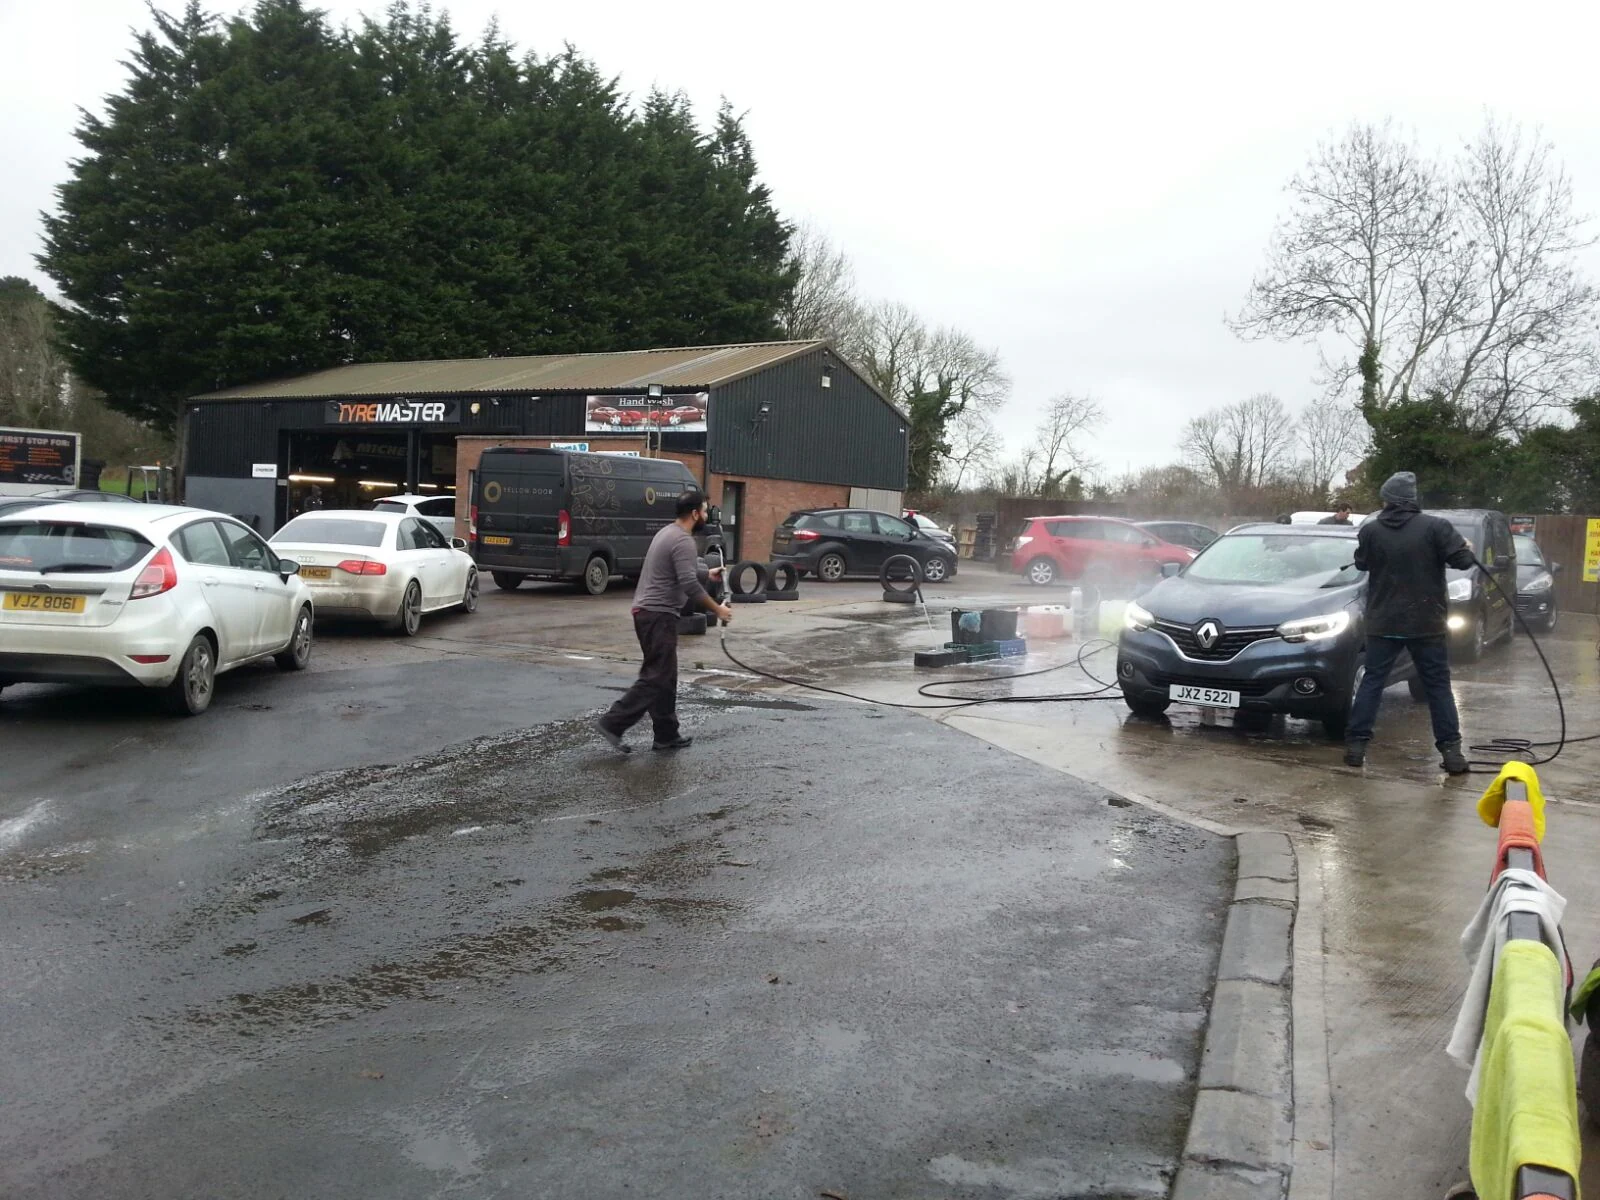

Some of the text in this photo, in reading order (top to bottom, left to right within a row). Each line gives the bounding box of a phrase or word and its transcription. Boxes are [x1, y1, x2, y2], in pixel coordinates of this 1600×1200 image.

[619, 397, 644, 405] Hand
[339, 402, 446, 422] TYREMASTER
[0, 435, 24, 443] FIRST
[26, 437, 49, 445] STOP
[532, 487, 553, 495] DOOR
[12, 594, 77, 609] VJZ 8061
[1177, 687, 1232, 704] JXZ 5221
